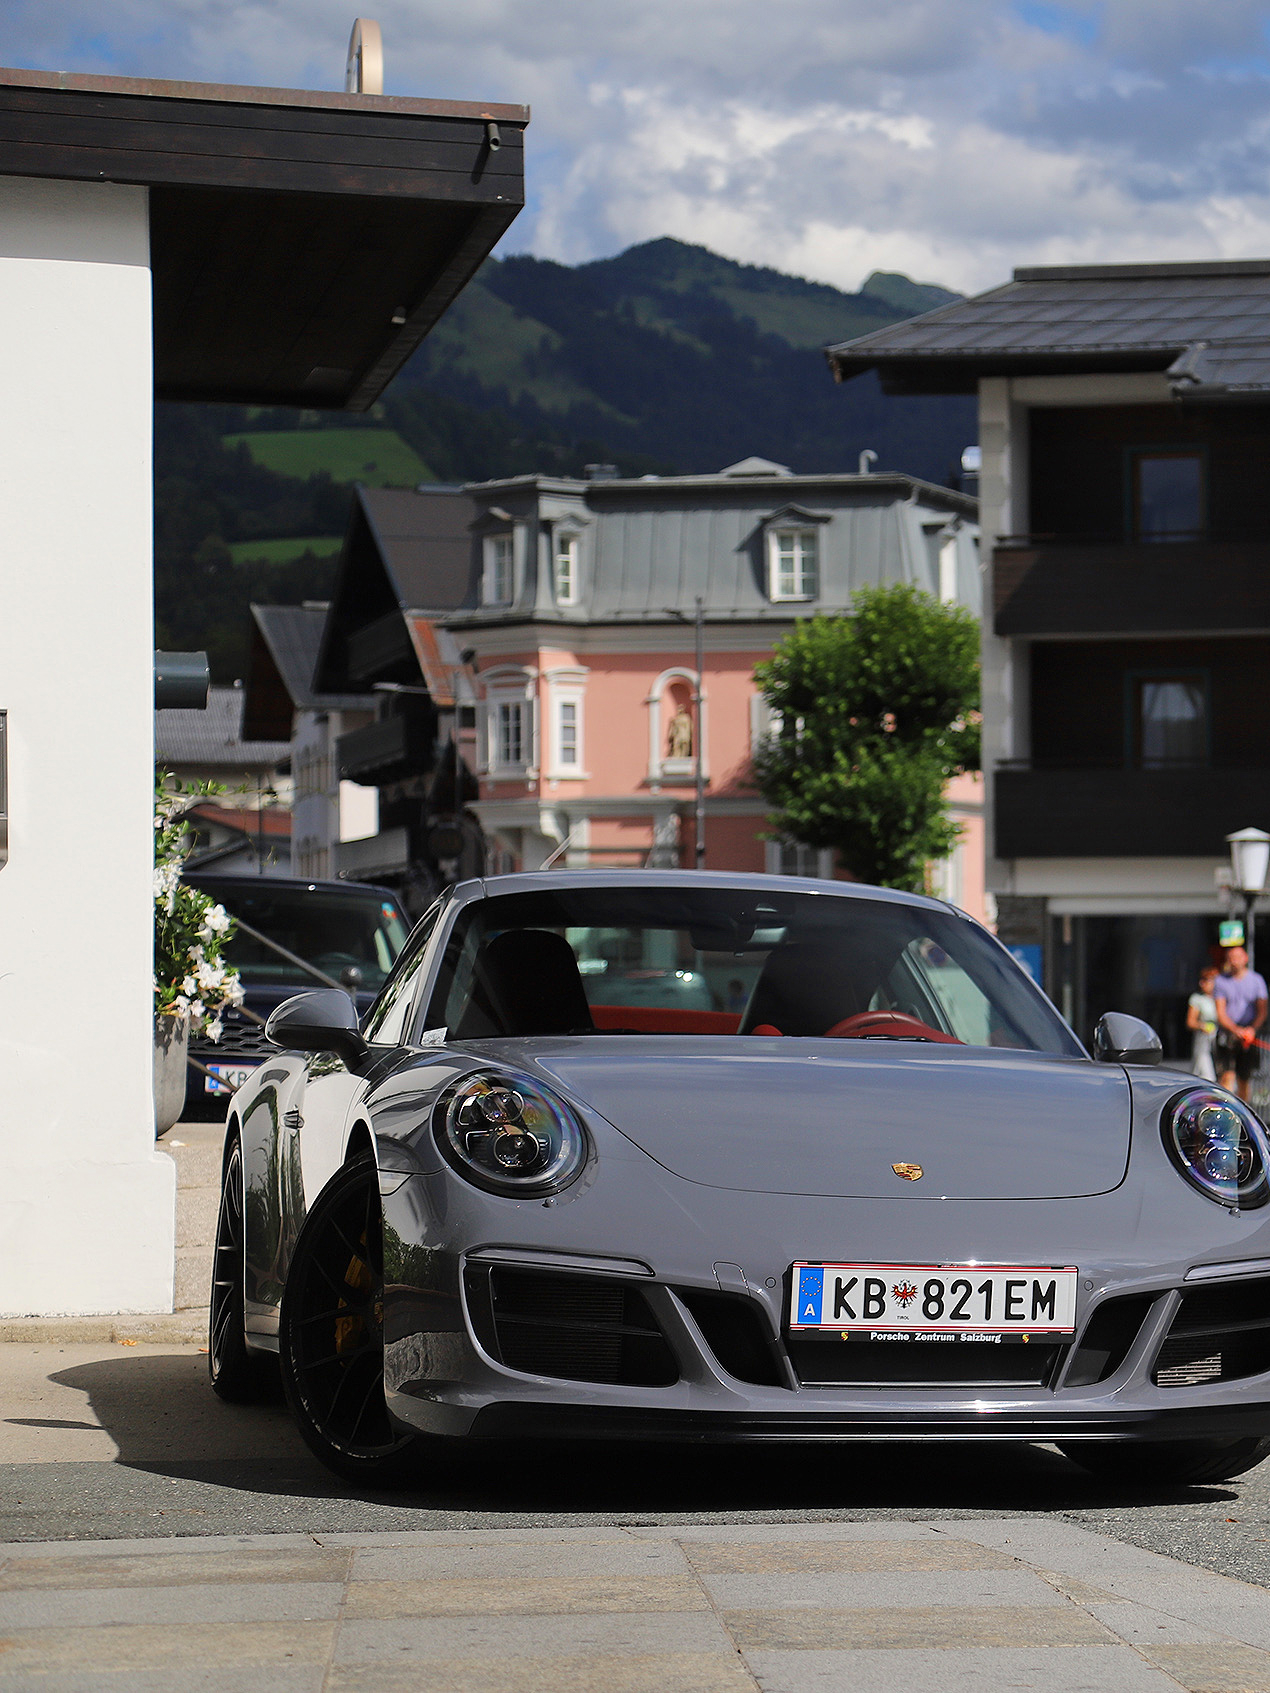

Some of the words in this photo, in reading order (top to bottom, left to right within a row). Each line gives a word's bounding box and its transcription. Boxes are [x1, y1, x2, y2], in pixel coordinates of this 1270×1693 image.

[834, 1276, 887, 1319] KB
[803, 1303, 816, 1316] A
[870, 1331, 910, 1341] Porsche
[915, 1332, 955, 1342] Zentrum
[960, 1333, 1002, 1344] Salzburg
